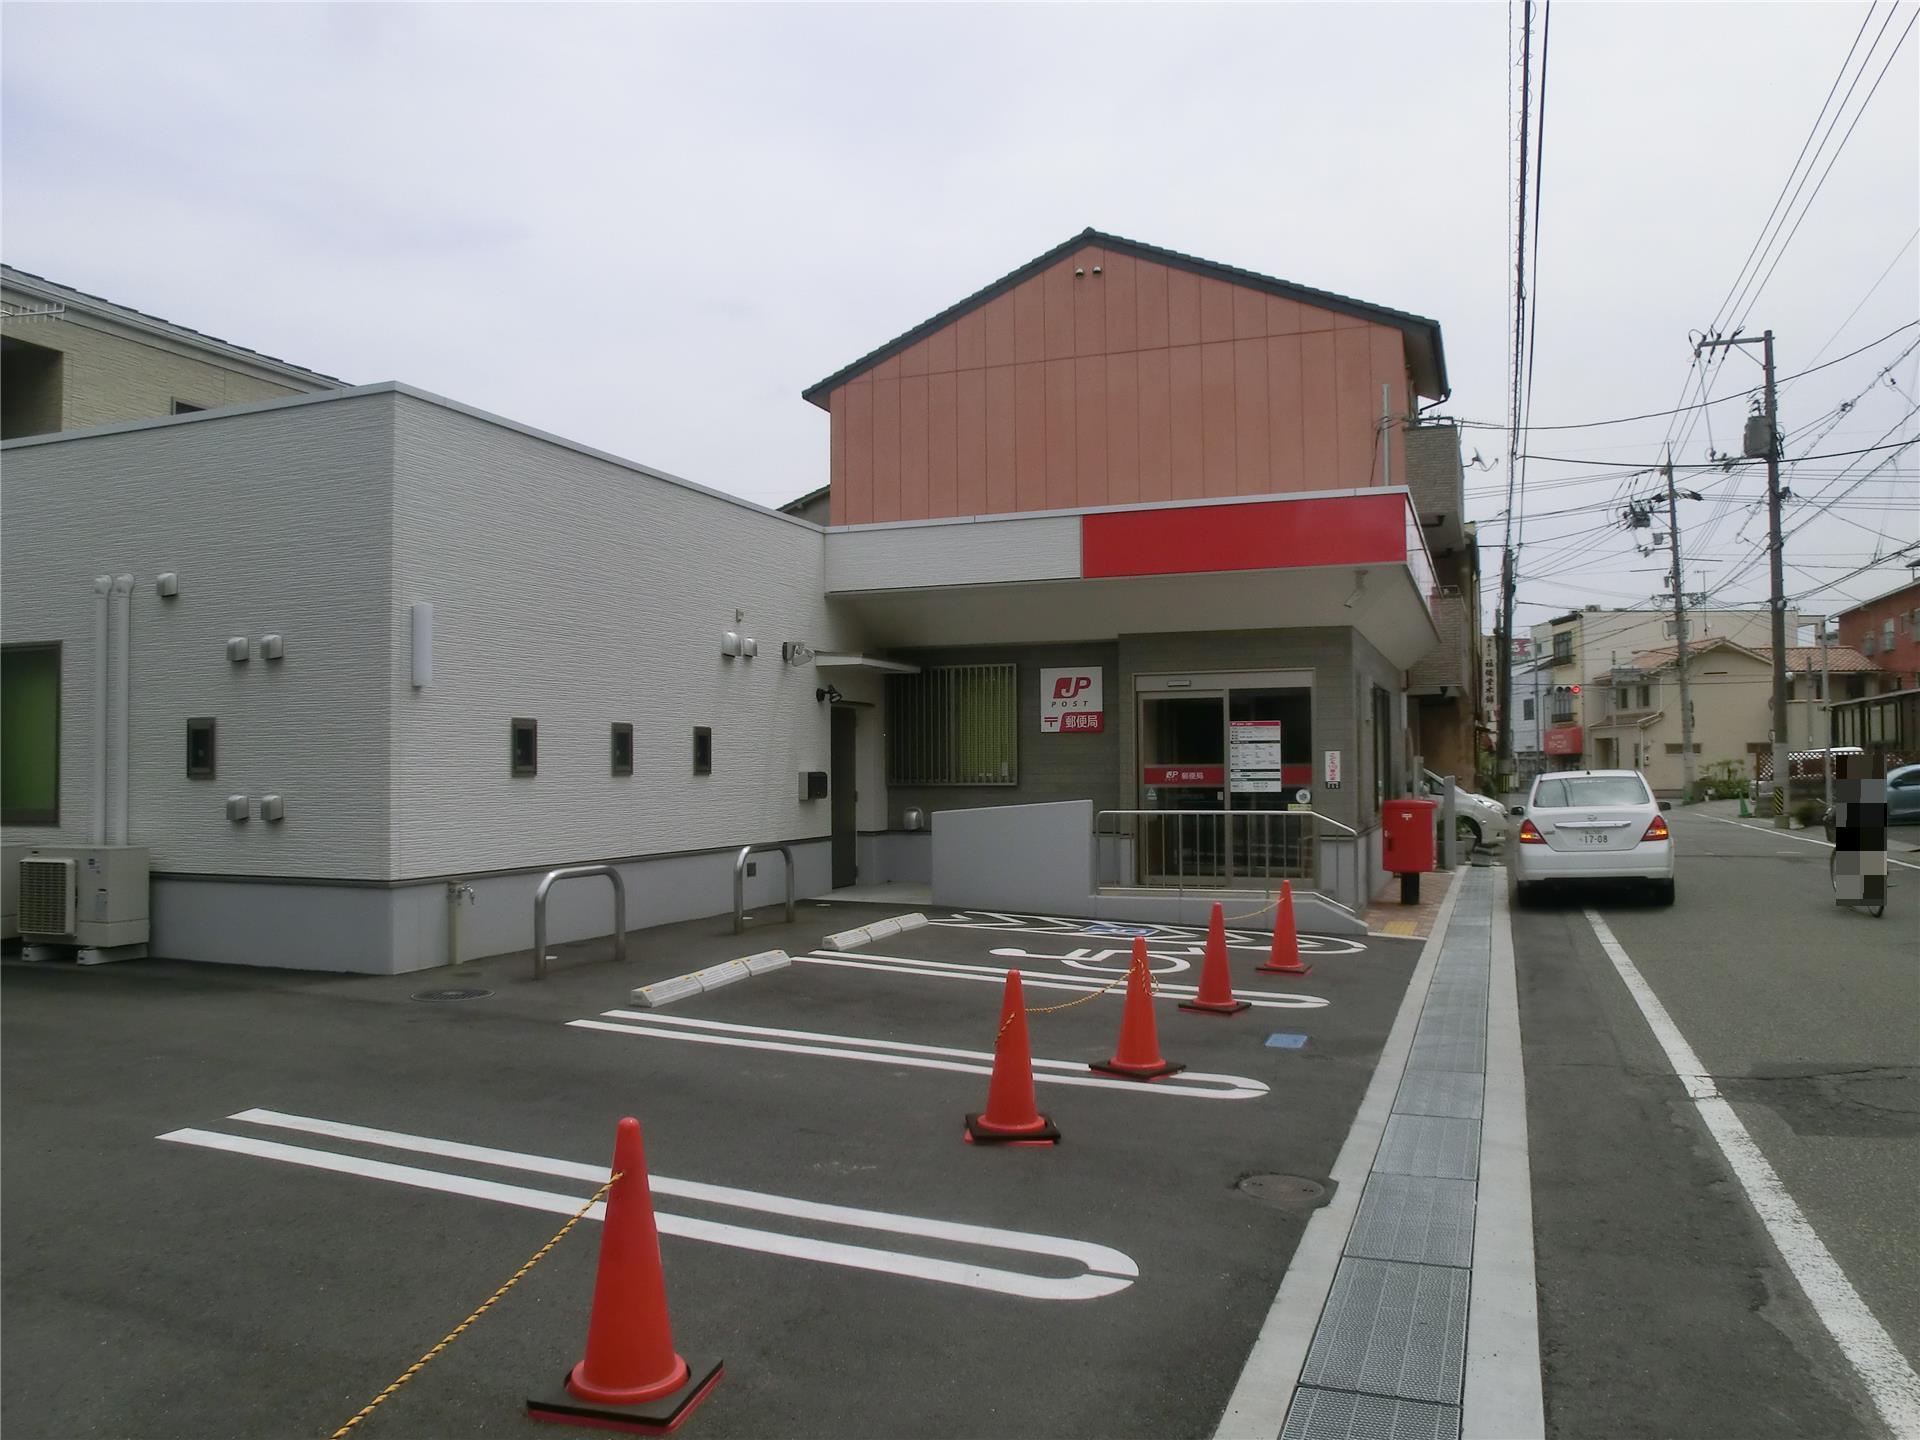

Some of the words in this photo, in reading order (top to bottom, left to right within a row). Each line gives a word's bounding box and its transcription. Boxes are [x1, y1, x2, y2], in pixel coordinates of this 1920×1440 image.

[1051, 700, 1089, 708] POST
[1065, 714, 1098, 728] 郵便局
[1584, 835, 1608, 844] 17-08
